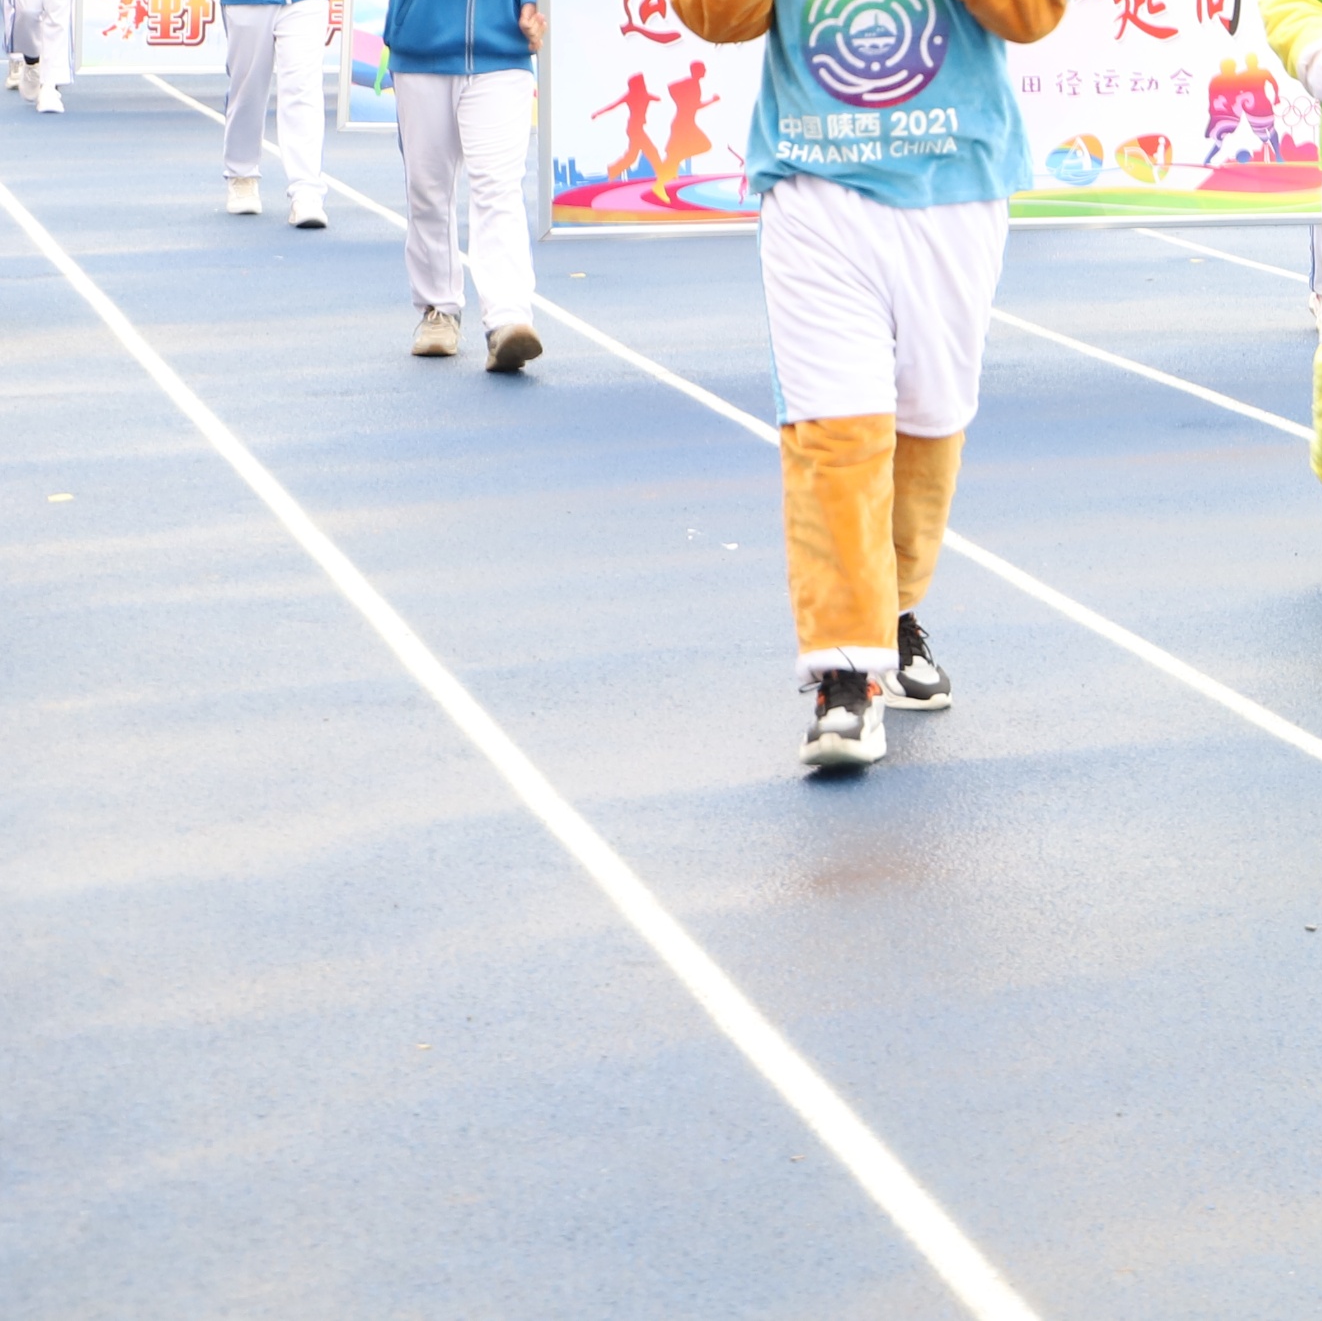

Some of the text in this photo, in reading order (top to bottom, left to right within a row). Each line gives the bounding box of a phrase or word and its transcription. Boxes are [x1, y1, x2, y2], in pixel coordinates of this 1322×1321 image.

[1022, 68, 1193, 96] 田径运动会
[779, 108, 958, 140] 中国 陕西 2021
[776, 137, 957, 163] SHAANXI CHINA
